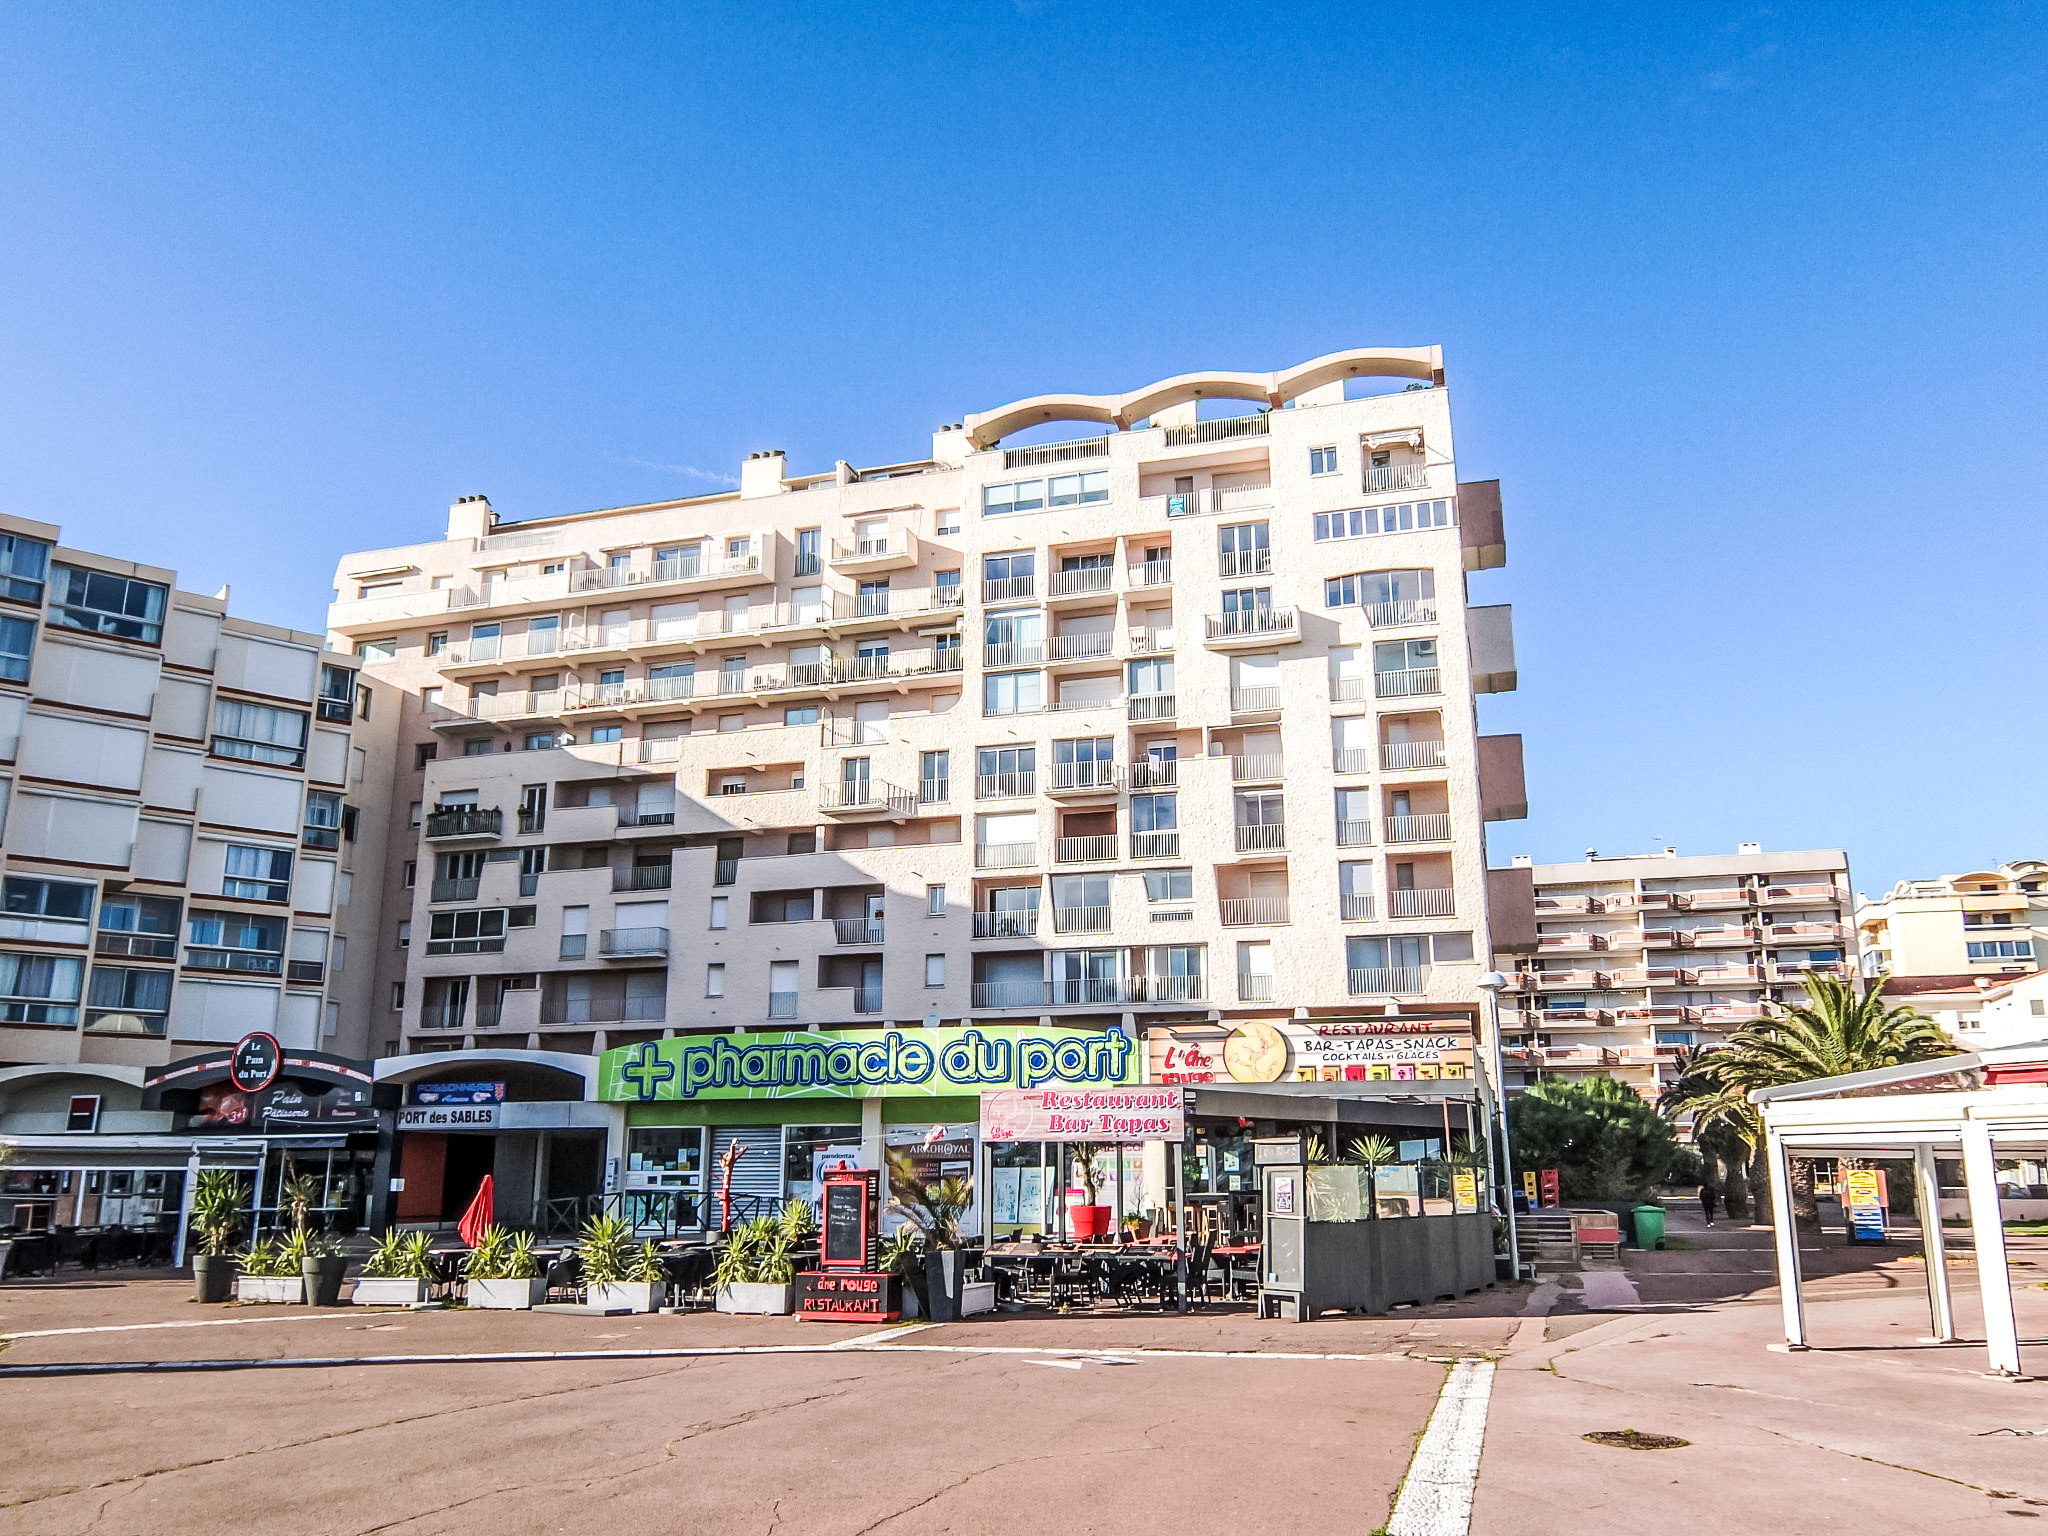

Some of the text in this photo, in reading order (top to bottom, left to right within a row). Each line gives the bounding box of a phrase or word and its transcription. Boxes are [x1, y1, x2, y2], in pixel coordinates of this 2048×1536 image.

[1318, 1022, 1433, 1036] RESTAURANT
[1304, 1037, 1457, 1051] BAR-TAPAS-SNACK
[245, 1056, 263, 1064] Pain
[681, 1026, 1132, 1097] pharmacie du port
[1322, 1052, 1384, 1061] COCKTAILS
[1397, 1051, 1439, 1060] GLACES
[239, 1070, 267, 1078] du Port
[272, 1091, 302, 1104] Pain
[1041, 1091, 1177, 1109] Restaurant
[399, 1110, 492, 1124] PORT des SABLES
[1049, 1114, 1169, 1134] Bar Tapas
[840, 1279, 878, 1293] rouge
